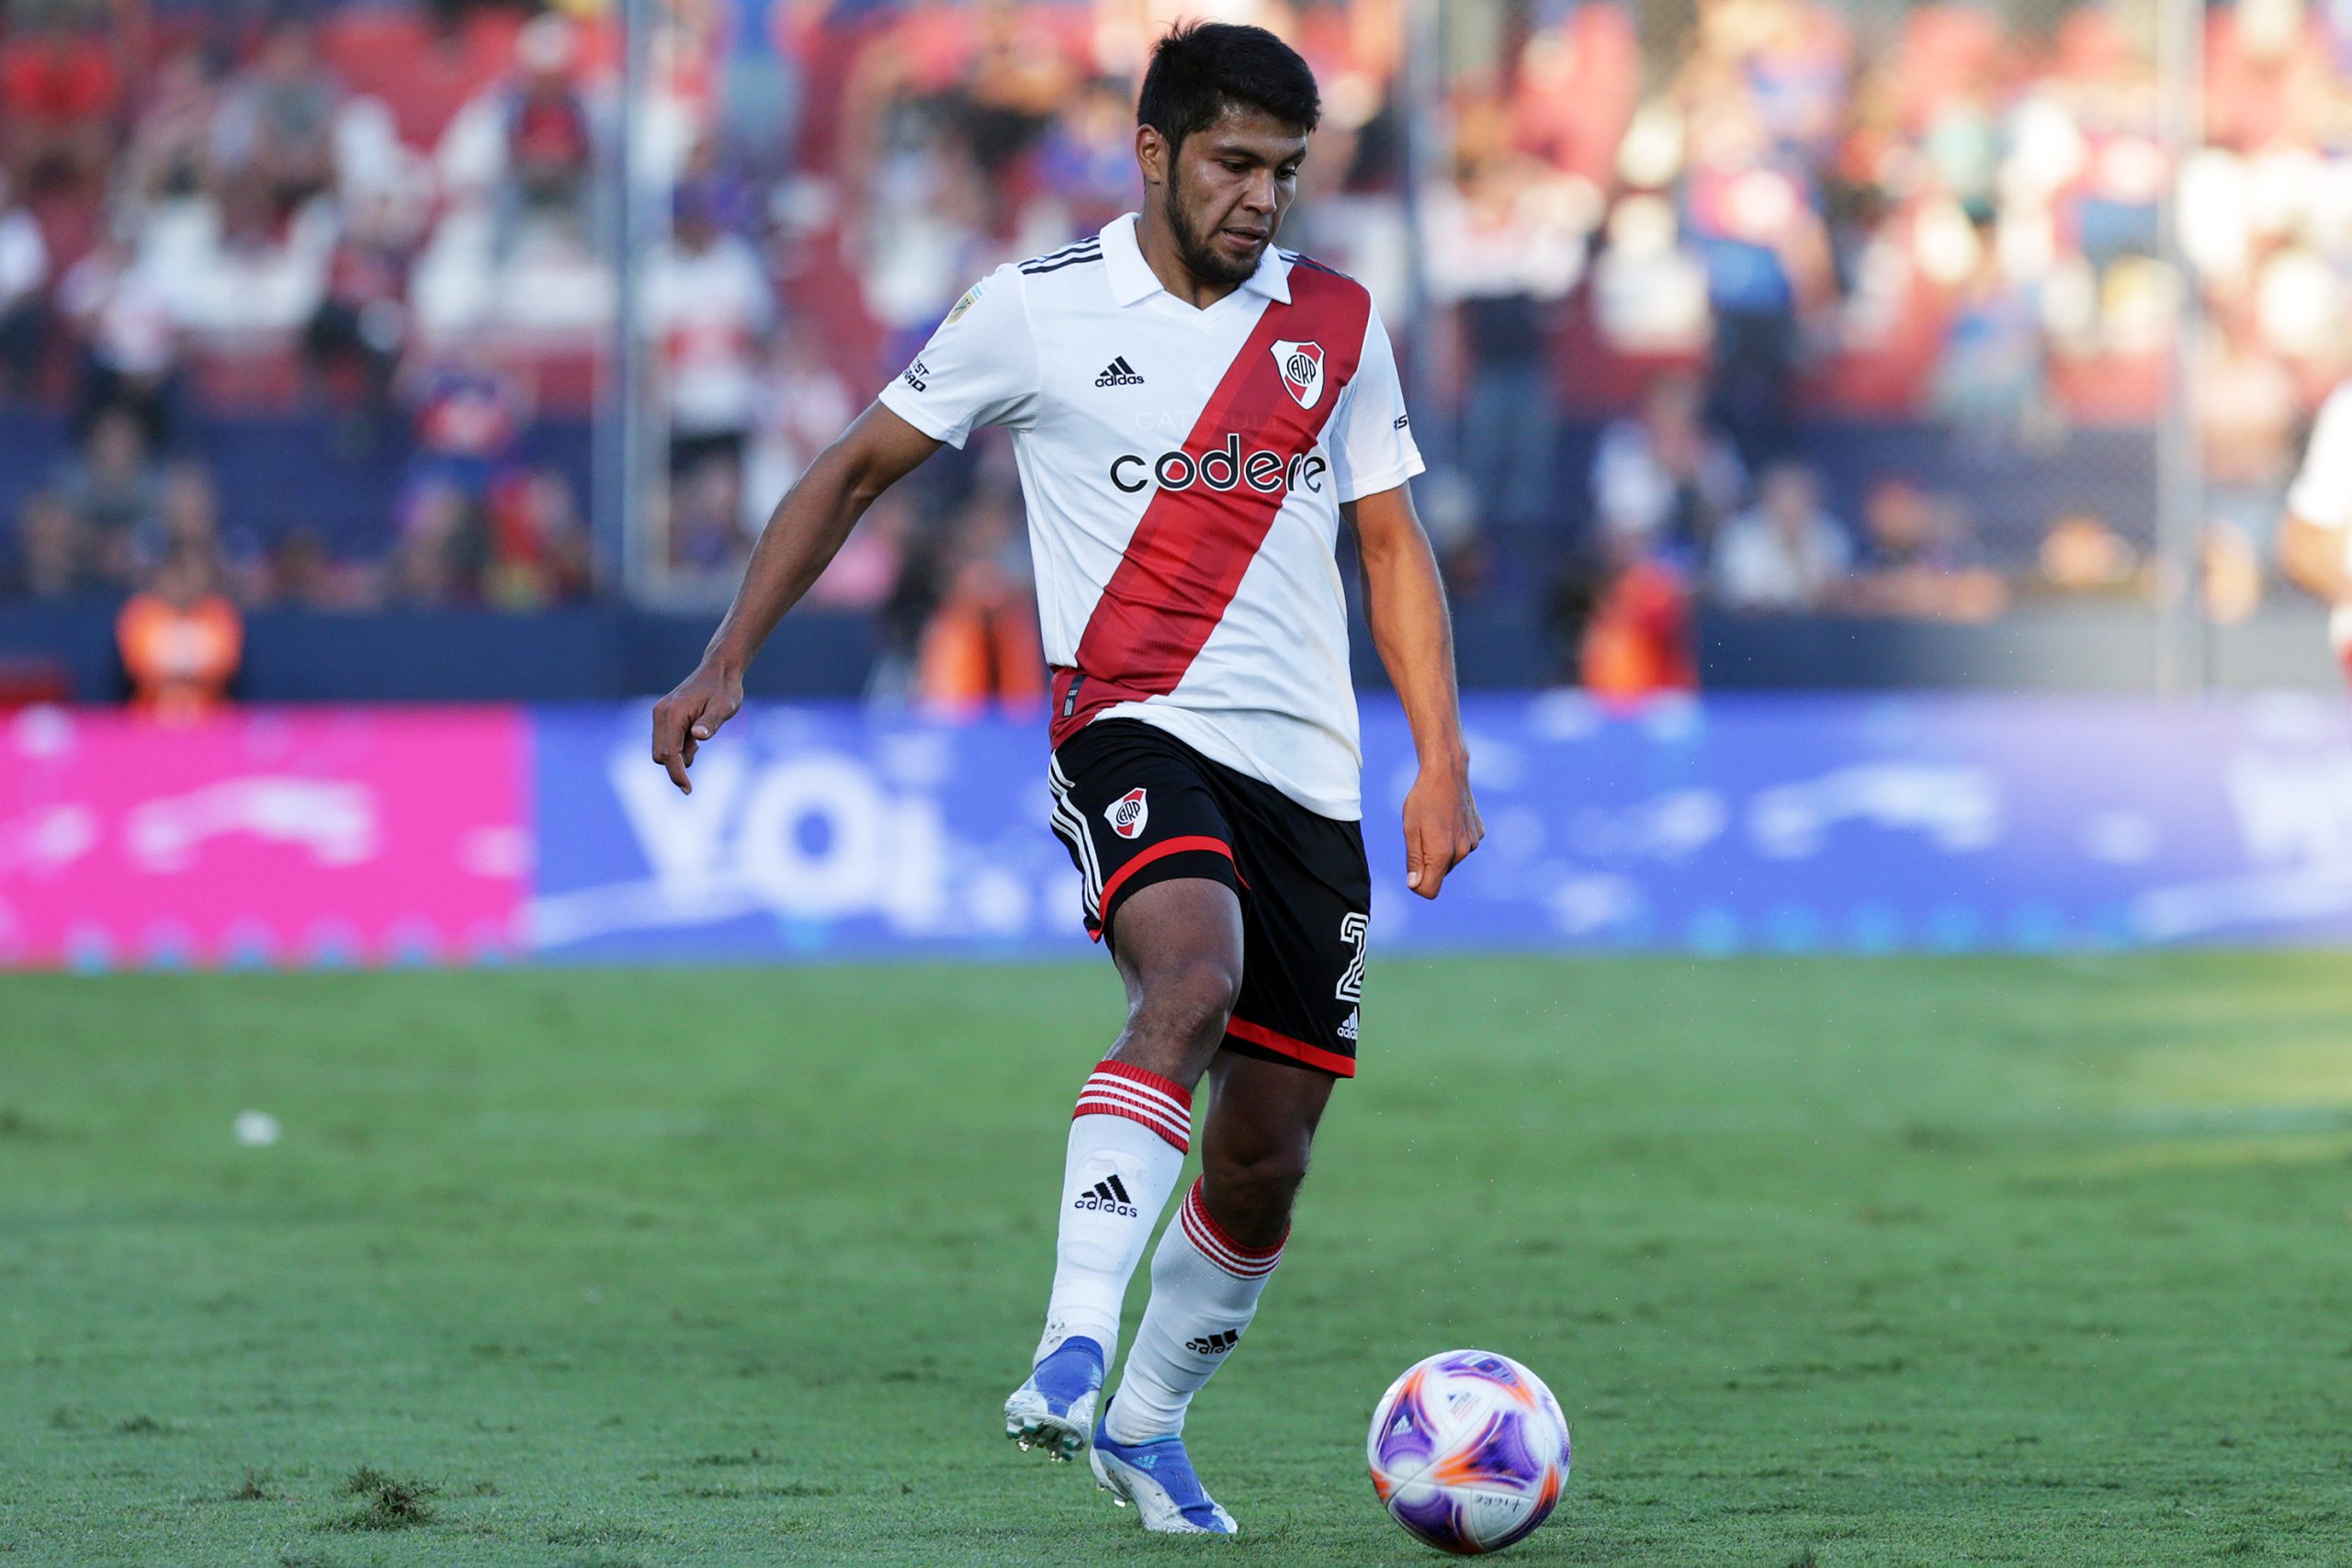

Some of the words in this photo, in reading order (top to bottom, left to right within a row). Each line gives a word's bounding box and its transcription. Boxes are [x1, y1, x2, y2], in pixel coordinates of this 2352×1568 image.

[1095, 374, 1144, 387] adidas
[1110, 433, 1327, 492] codere
[1336, 912, 1369, 1003] 2
[1074, 1197, 1137, 1218] adidas
